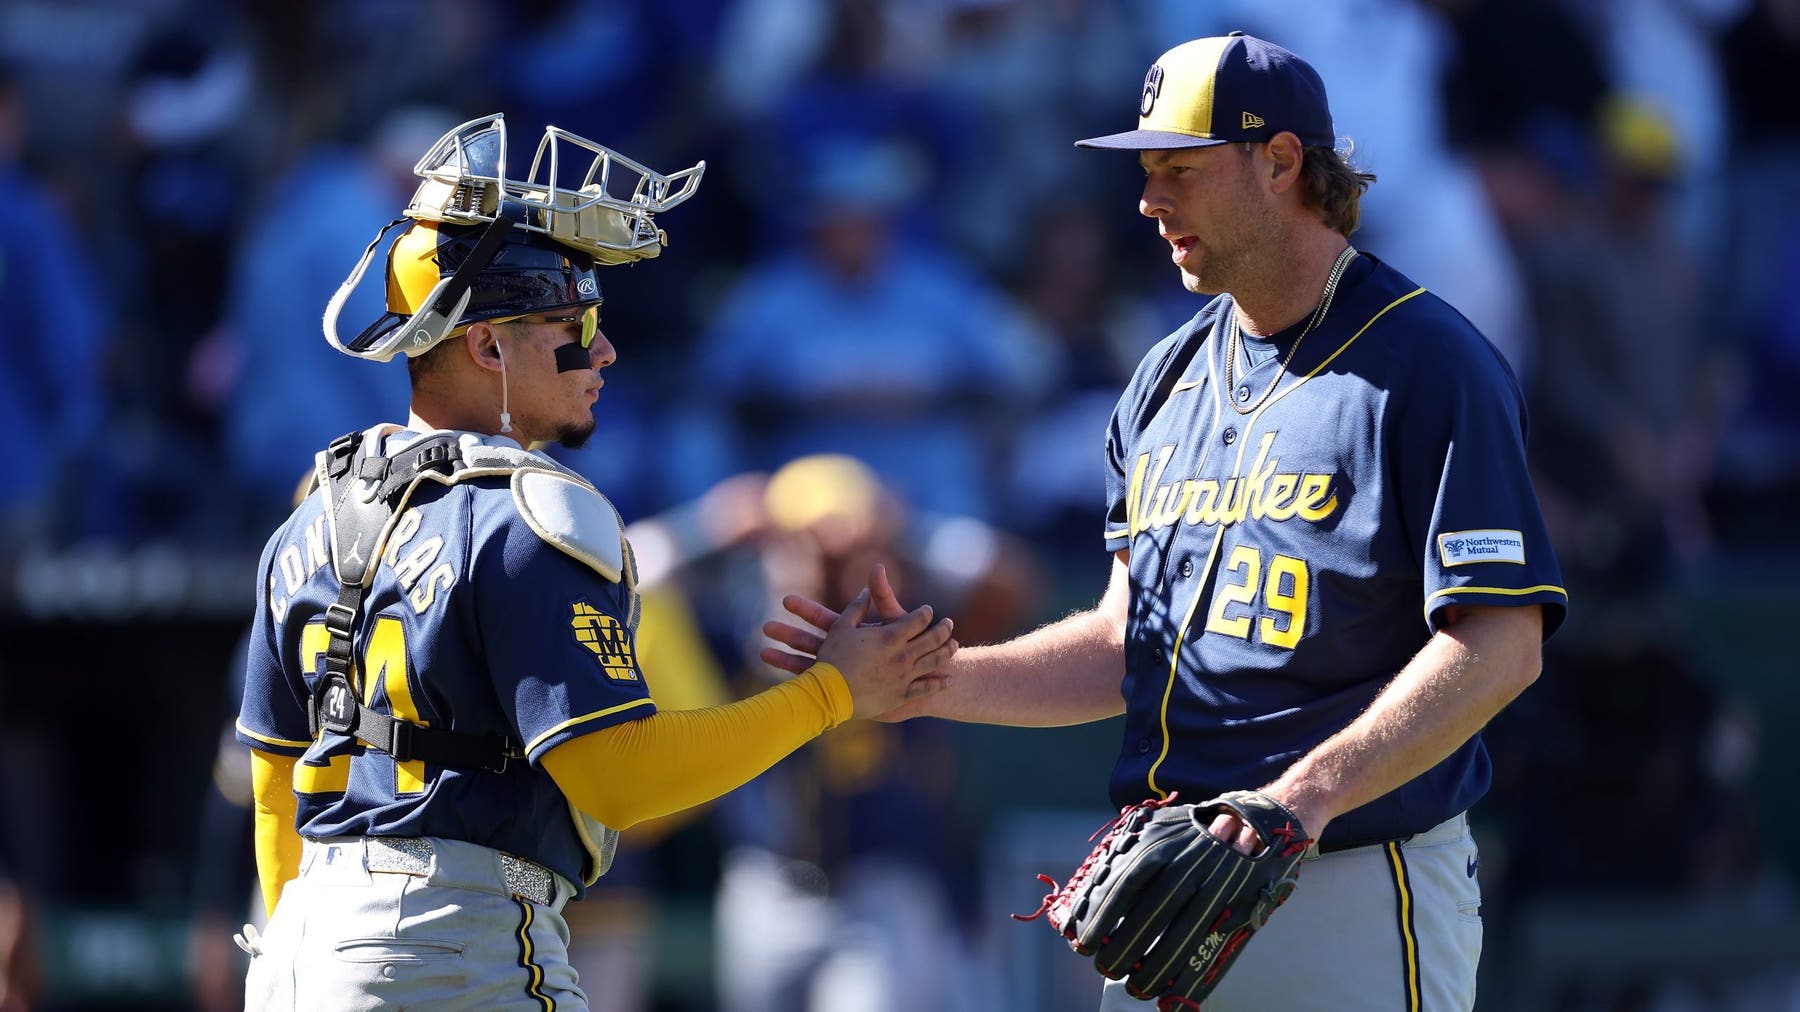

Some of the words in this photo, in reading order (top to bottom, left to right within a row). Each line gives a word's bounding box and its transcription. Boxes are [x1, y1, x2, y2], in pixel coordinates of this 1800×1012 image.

[1126, 430, 1339, 542] Mlwaukee
[1465, 537, 1521, 547] Northwestern
[1467, 546, 1499, 554] Mutual
[270, 506, 457, 625] CONRAS
[1204, 545, 1310, 649] 29
[329, 685, 347, 719] 24
[1189, 931, 1226, 971] S.E.M.
